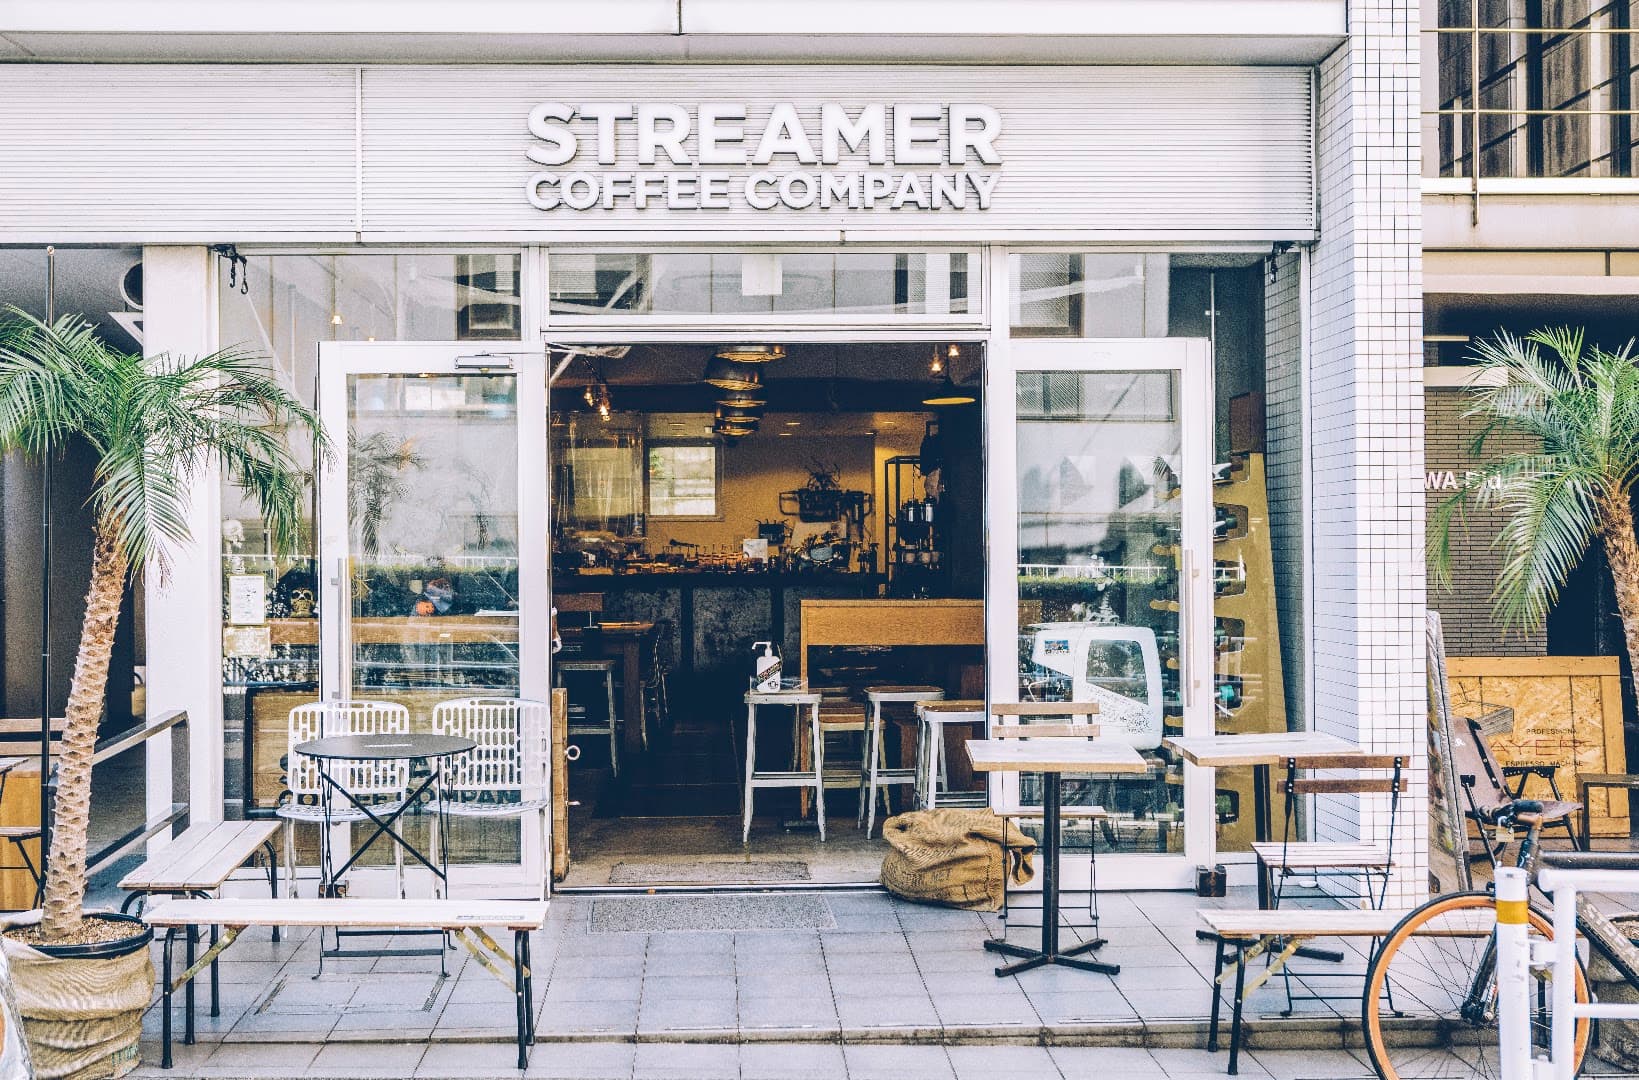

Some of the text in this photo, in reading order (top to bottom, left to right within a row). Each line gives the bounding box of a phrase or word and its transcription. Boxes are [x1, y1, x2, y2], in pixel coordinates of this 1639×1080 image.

[525, 101, 1003, 166] STREAMER
[525, 171, 1002, 211] COFFEE COMPANY
